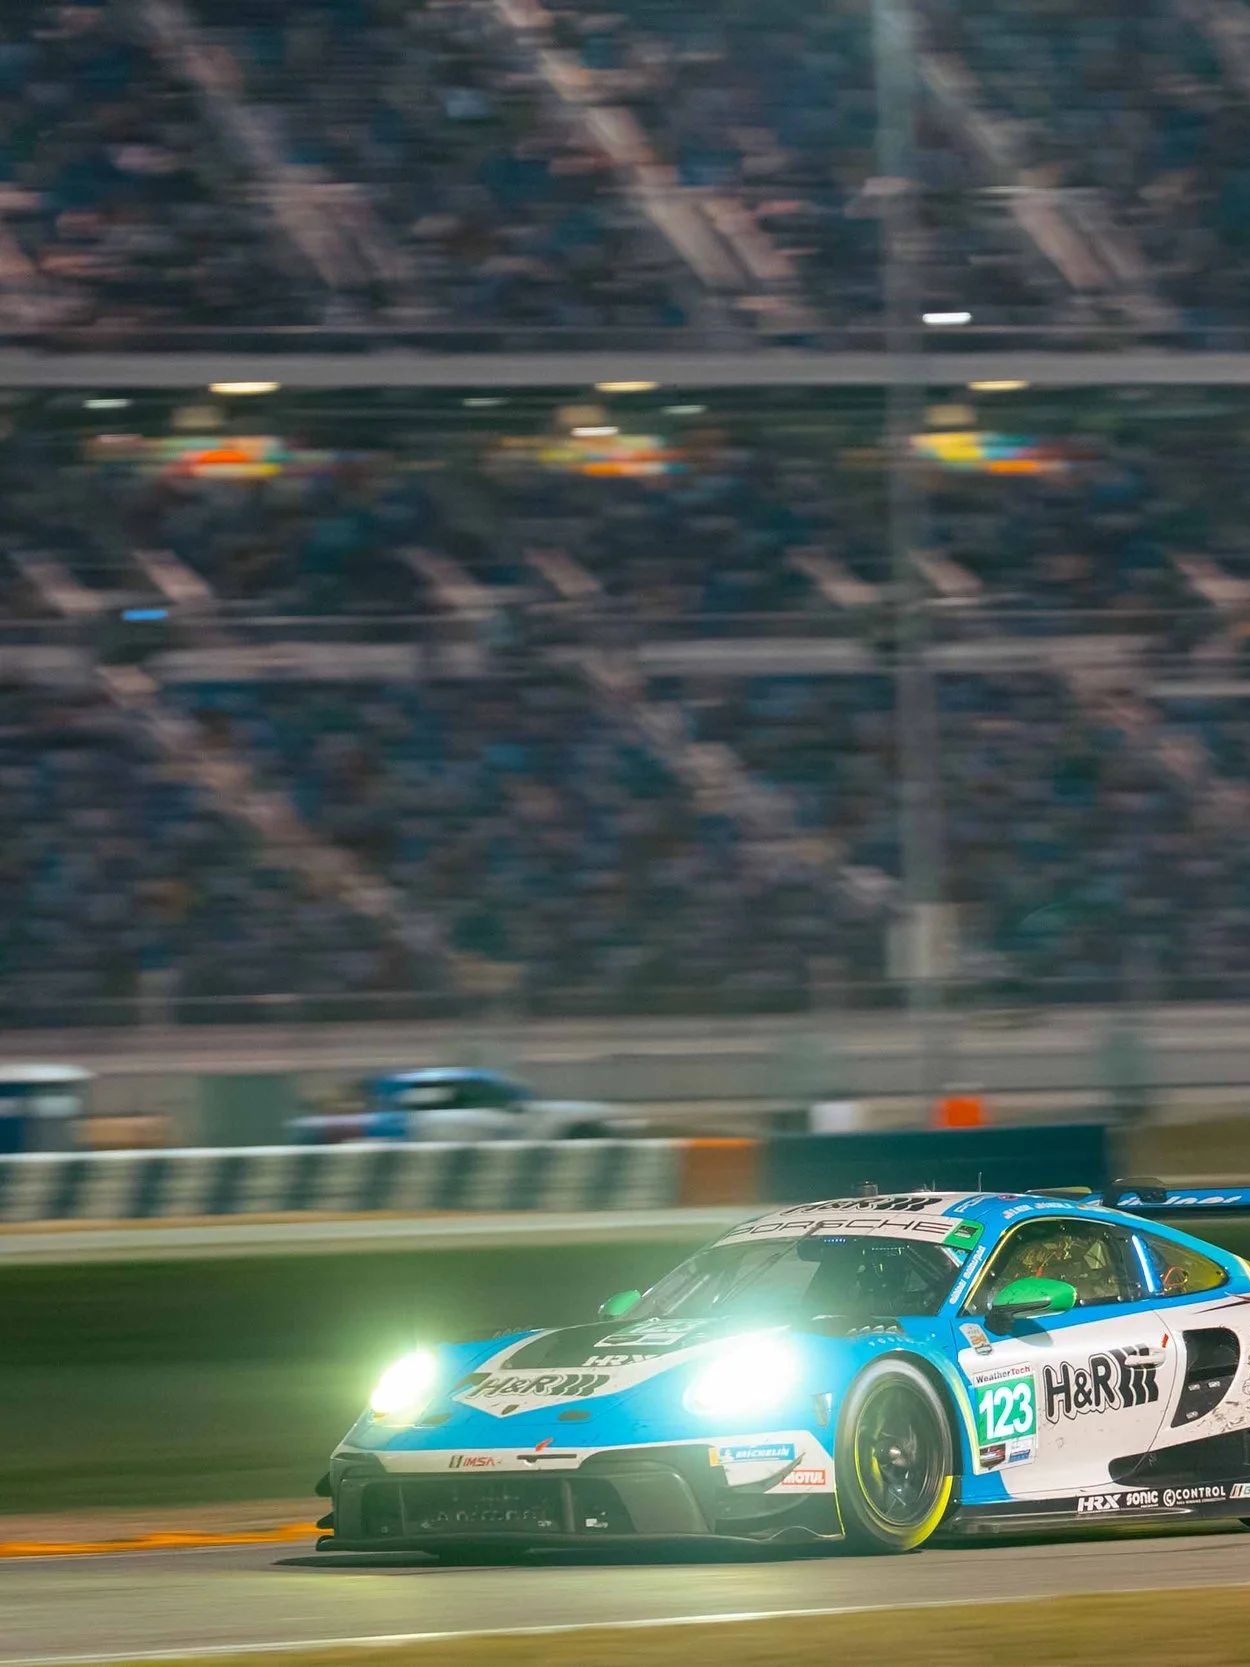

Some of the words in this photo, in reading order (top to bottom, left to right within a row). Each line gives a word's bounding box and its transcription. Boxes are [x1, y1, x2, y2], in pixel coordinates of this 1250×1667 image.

[728, 1219, 954, 1237] PORSCHE
[976, 1366, 1032, 1384] WeatherTech
[979, 1382, 1034, 1440] 123
[464, 1456, 496, 1467] IMSA
[735, 1447, 790, 1459] MICHELIN
[783, 1470, 825, 1484] MOTUL
[1078, 1497, 1121, 1512] HRX
[1176, 1485, 1226, 1500] CONTROL
